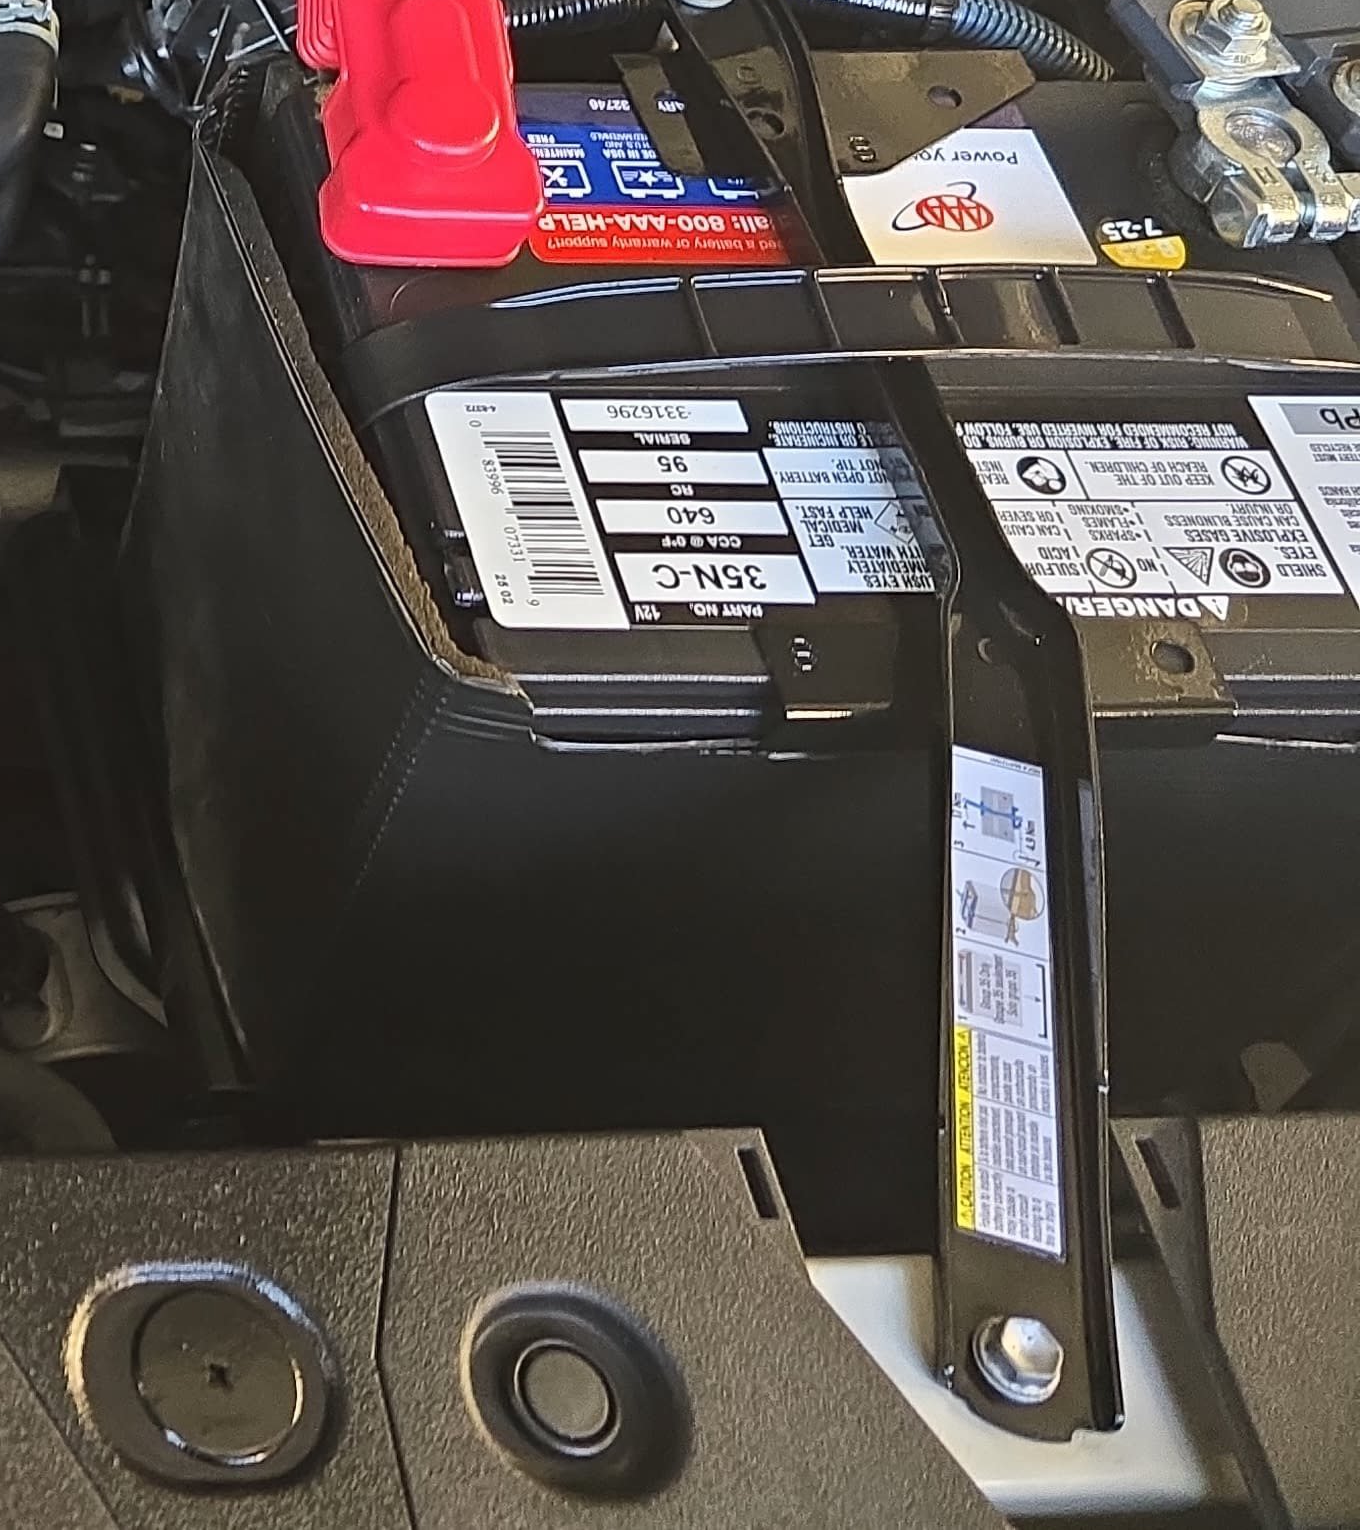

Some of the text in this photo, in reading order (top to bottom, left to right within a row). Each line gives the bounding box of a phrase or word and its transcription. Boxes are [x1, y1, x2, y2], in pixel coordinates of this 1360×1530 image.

[531, 148, 585, 158] MAINTEN
[602, 148, 624, 158] USA
[951, 150, 1019, 165] Power
[928, 197, 982, 230] AAA
[538, 213, 772, 231] all: 800-AAA-HELP
[1102, 218, 1163, 241] 7-25
[547, 235, 607, 249] support?
[613, 234, 672, 249] warranty
[676, 238, 690, 250] or
[694, 236, 743, 251] battery
[746, 240, 755, 249] a
[634, 433, 691, 445] SERIAL
[1027, 436, 1045, 448] OR
[1047, 436, 1109, 448] EXPLOSION
[1160, 437, 1186, 448] RISK
[657, 455, 689, 473] 95
[831, 459, 855, 470] TIP.
[1312, 454, 1337, 462] MUST
[1085, 461, 1208, 473] REACH OF CHILDREN.
[774, 471, 831, 483] BATTERY.
[832, 471, 863, 483] OPEN
[1113, 474, 1215, 486] KEEP OUT OF THE
[670, 485, 694, 496] RC
[795, 505, 873, 520] HELP FAST.
[1225, 503, 1293, 514] OR INJURY.
[666, 506, 715, 525] 640
[997, 511, 1054, 522] OR SEVER
[1164, 515, 1300, 526] CAN CAUSE BLINDNESS
[800, 520, 864, 534] MEDICAL
[1037, 525, 1060, 536] CAN
[706, 535, 742, 548] CCA
[809, 534, 835, 547] GET
[1184, 529, 1308, 542] EXPLOSIVE GASES
[503, 526, 526, 562] 07331
[840, 545, 921, 559] ITH WATER.
[1037, 547, 1070, 559] ACID
[1274, 546, 1317, 559] EYES.
[1024, 563, 1079, 576] SULFUR
[1137, 559, 1156, 572] NO
[1276, 564, 1327, 577] SHIELD
[651, 564, 767, 591] 35N-C
[863, 575, 898, 587] EYES
[633, 604, 661, 621] 12V
[689, 603, 763, 617] PART NO.
[959, 1101, 971, 1155] ATTENTION
[959, 1164, 972, 1207] CAUTION
